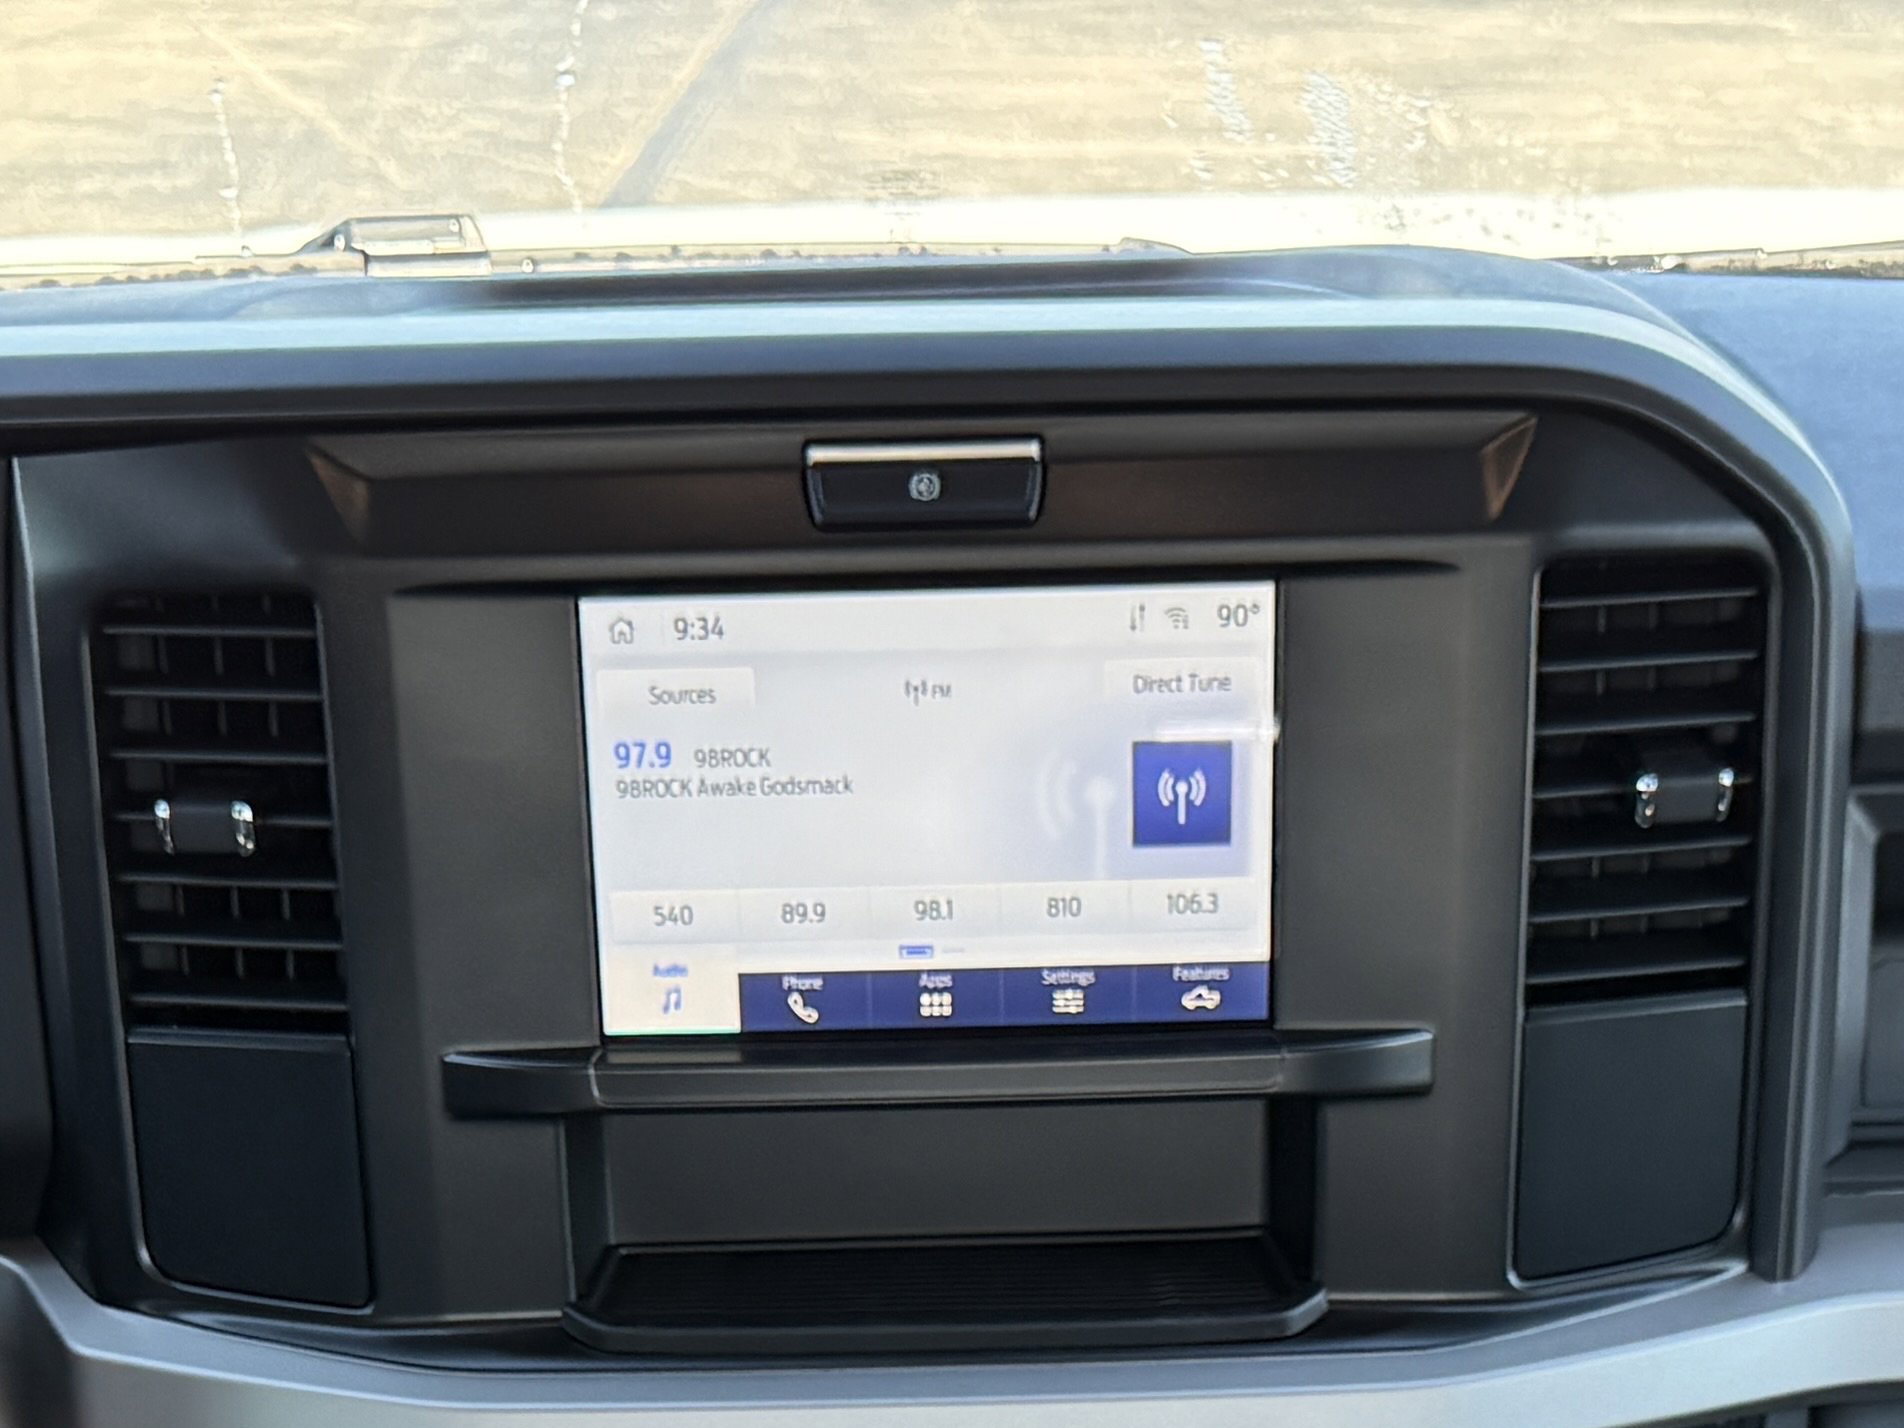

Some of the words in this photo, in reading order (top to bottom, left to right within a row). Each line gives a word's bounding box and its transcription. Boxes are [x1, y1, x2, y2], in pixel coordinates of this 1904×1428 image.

[1216, 603, 1261, 628] 90°
[673, 617, 724, 641] 9:34
[1132, 674, 1183, 694] Direct
[1188, 673, 1232, 692] Tune
[648, 685, 717, 705] Sources
[613, 742, 672, 769] 97.9
[694, 747, 771, 768] 98ROCK
[616, 779, 692, 799] 98ROCK
[697, 776, 757, 798] Awake
[760, 776, 853, 796] Godsmack
[653, 905, 694, 926] 540
[781, 902, 826, 924] 89.9
[914, 899, 954, 921] 98.1
[1046, 896, 1082, 918] 810
[1166, 893, 1219, 916] 106.3
[782, 975, 824, 992] Phone
[919, 973, 953, 988] Apps
[1041, 969, 1096, 987] Settings
[1172, 966, 1230, 983] Features
